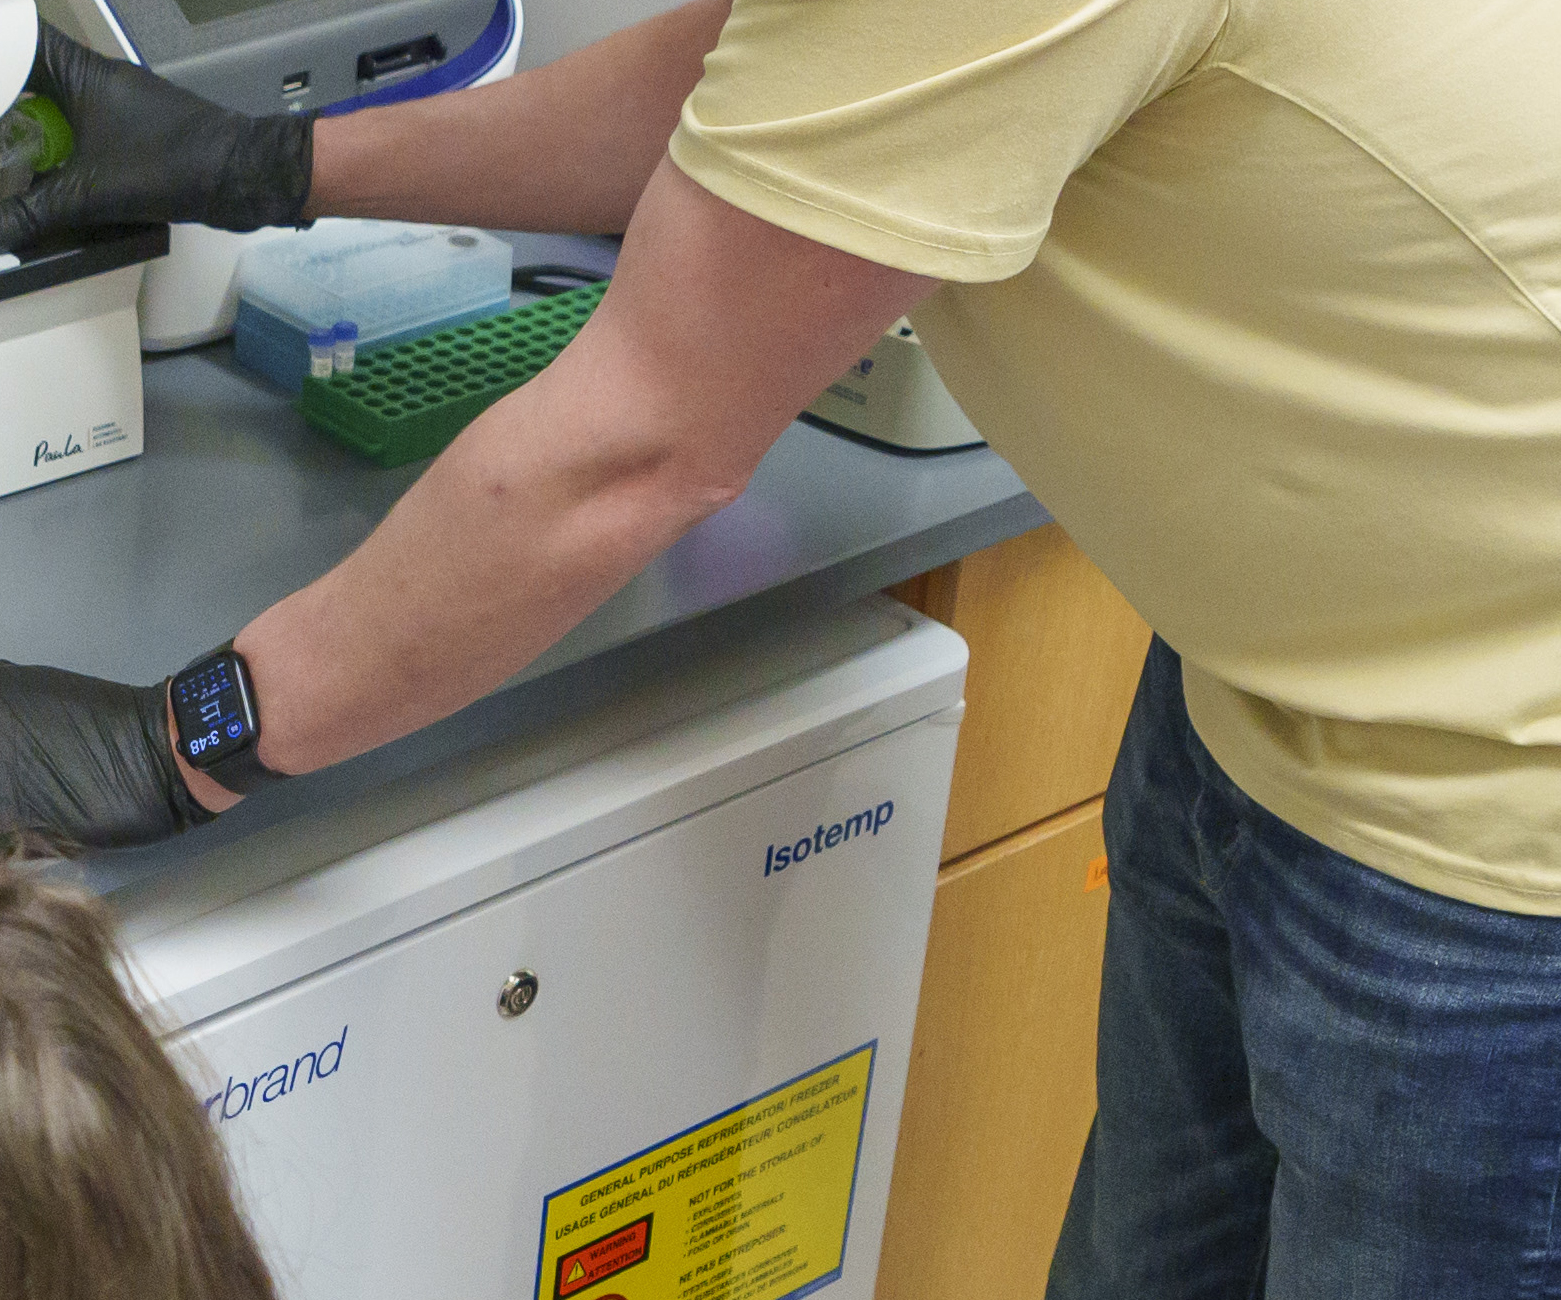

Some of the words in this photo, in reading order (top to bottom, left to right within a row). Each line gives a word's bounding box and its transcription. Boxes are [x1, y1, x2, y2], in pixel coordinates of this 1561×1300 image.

[34, 434, 83, 467] Paula
[190, 730, 220, 755] 3:48
[764, 799, 894, 877] Isotemp
[580, 1173, 636, 1207] GENERAL
[639, 1144, 694, 1179] PURPOSE
[789, 1074, 840, 1106] FREEZER
[689, 1190, 710, 1207] NOT
[713, 1178, 734, 1196] FOR
[738, 1165, 758, 1183] THE
[759, 1141, 809, 1173] STORAGE
[555, 1212, 596, 1241] USAGE
[657, 1174, 674, 1192] DU
[590, 1232, 636, 1260] WARNING
[587, 1247, 642, 1279] ATTENTION
[679, 1272, 693, 1286] NE
[695, 1259, 716, 1277] PAS
